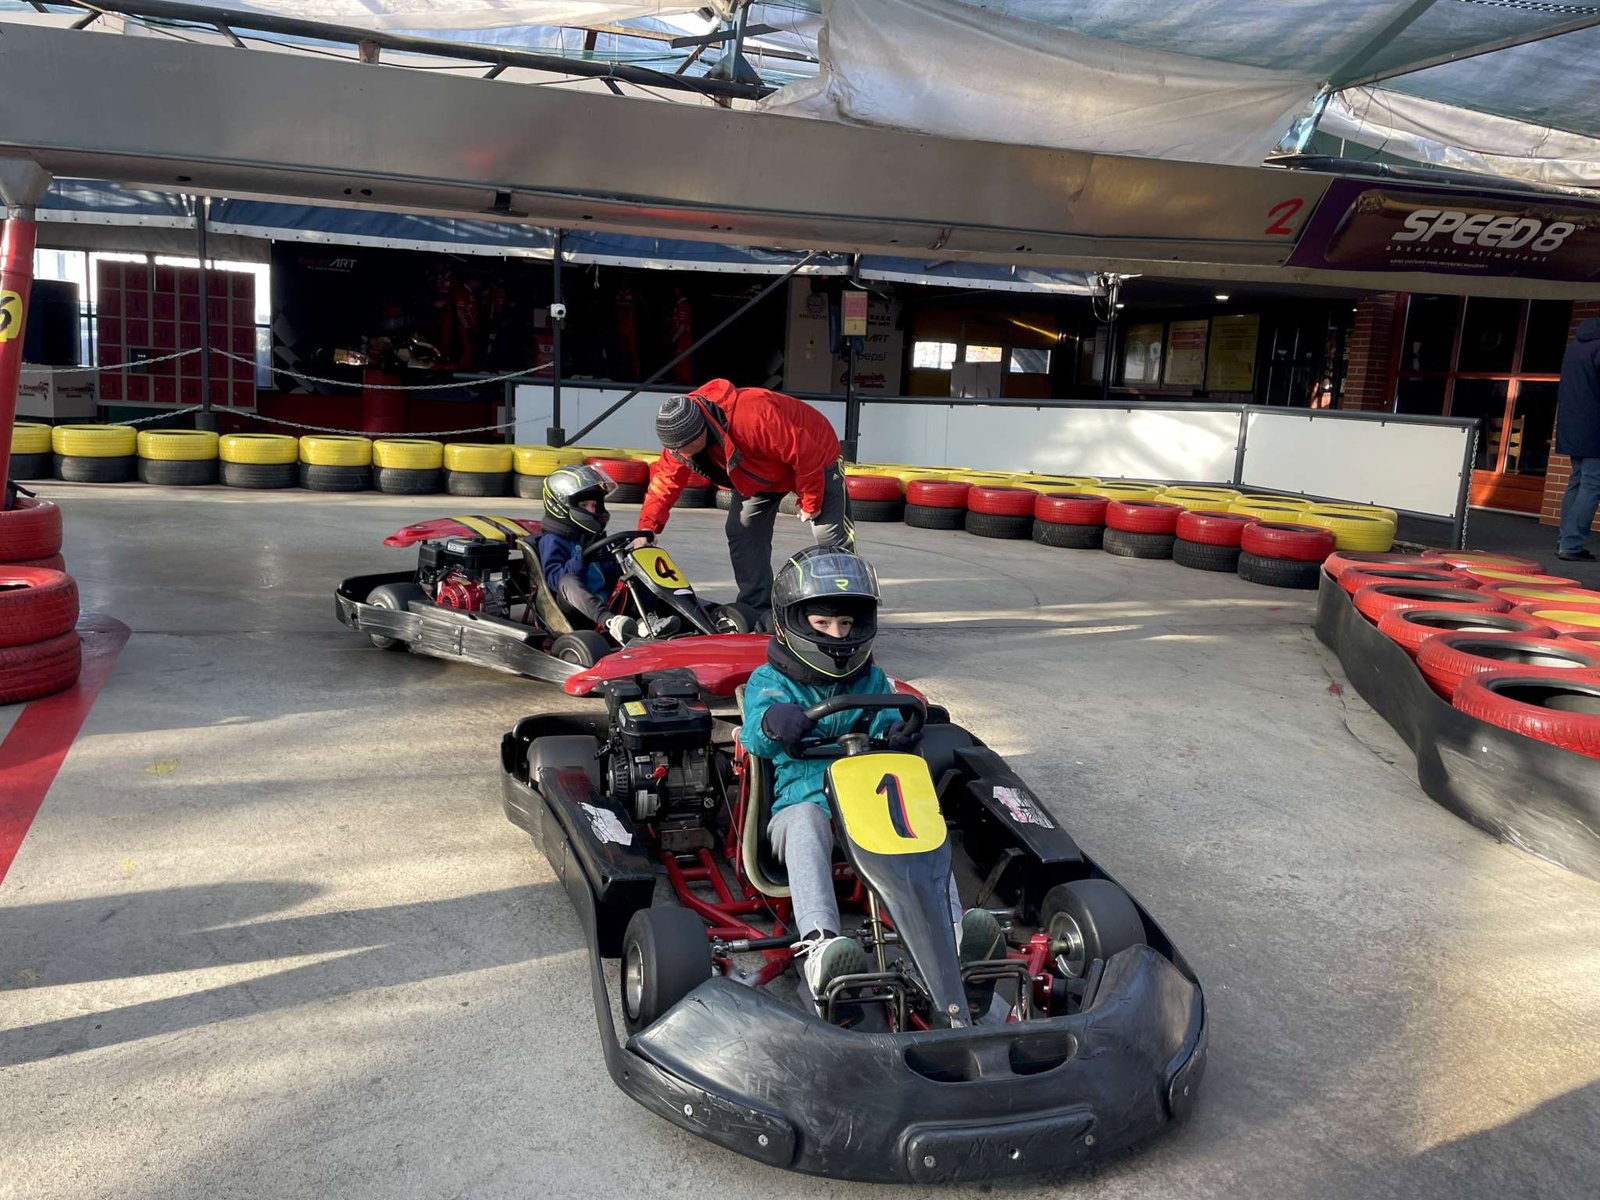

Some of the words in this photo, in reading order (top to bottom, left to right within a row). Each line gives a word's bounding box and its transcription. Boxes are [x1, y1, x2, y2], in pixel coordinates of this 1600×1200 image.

[1264, 198, 1304, 235] 2
[1391, 209, 1576, 252] SPEED8
[1385, 245, 1457, 255] absolute
[1468, 250, 1548, 263] stimulant
[654, 556, 679, 582] 4
[875, 772, 919, 840] 1
